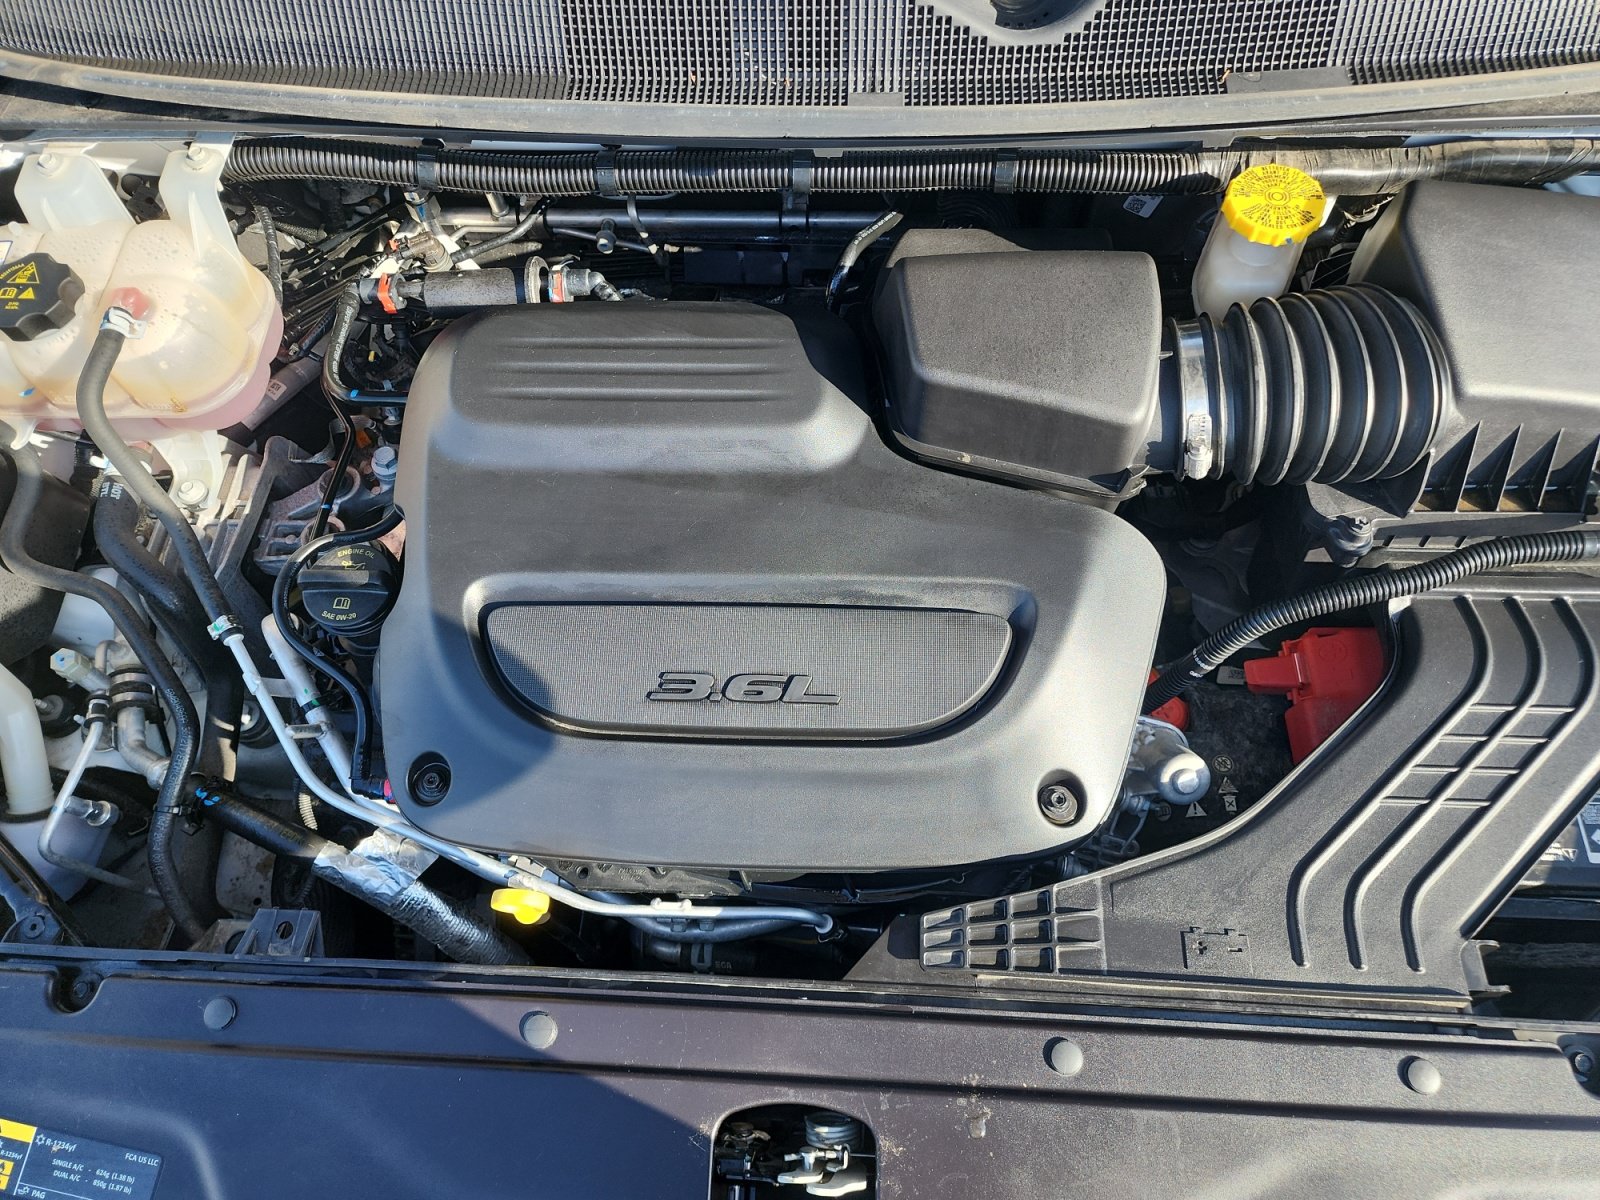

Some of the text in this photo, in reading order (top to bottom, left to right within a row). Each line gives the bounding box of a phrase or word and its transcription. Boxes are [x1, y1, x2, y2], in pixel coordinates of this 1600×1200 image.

[111, 482, 123, 499] HOT
[337, 548, 374, 559] ENGINE OIL
[322, 610, 357, 621] SAE 0W-20
[646, 672, 841, 704] 3.6L
[45, 1138, 77, 1152] R-1234yf
[52, 1159, 72, 1168] SINGLE
[125, 1153, 137, 1162] FCA
[147, 1158, 159, 1166] LLC
[53, 1170, 68, 1179] DUAL
[69, 1174, 81, 1182] A/C
[31, 1190, 46, 1199] PAG
